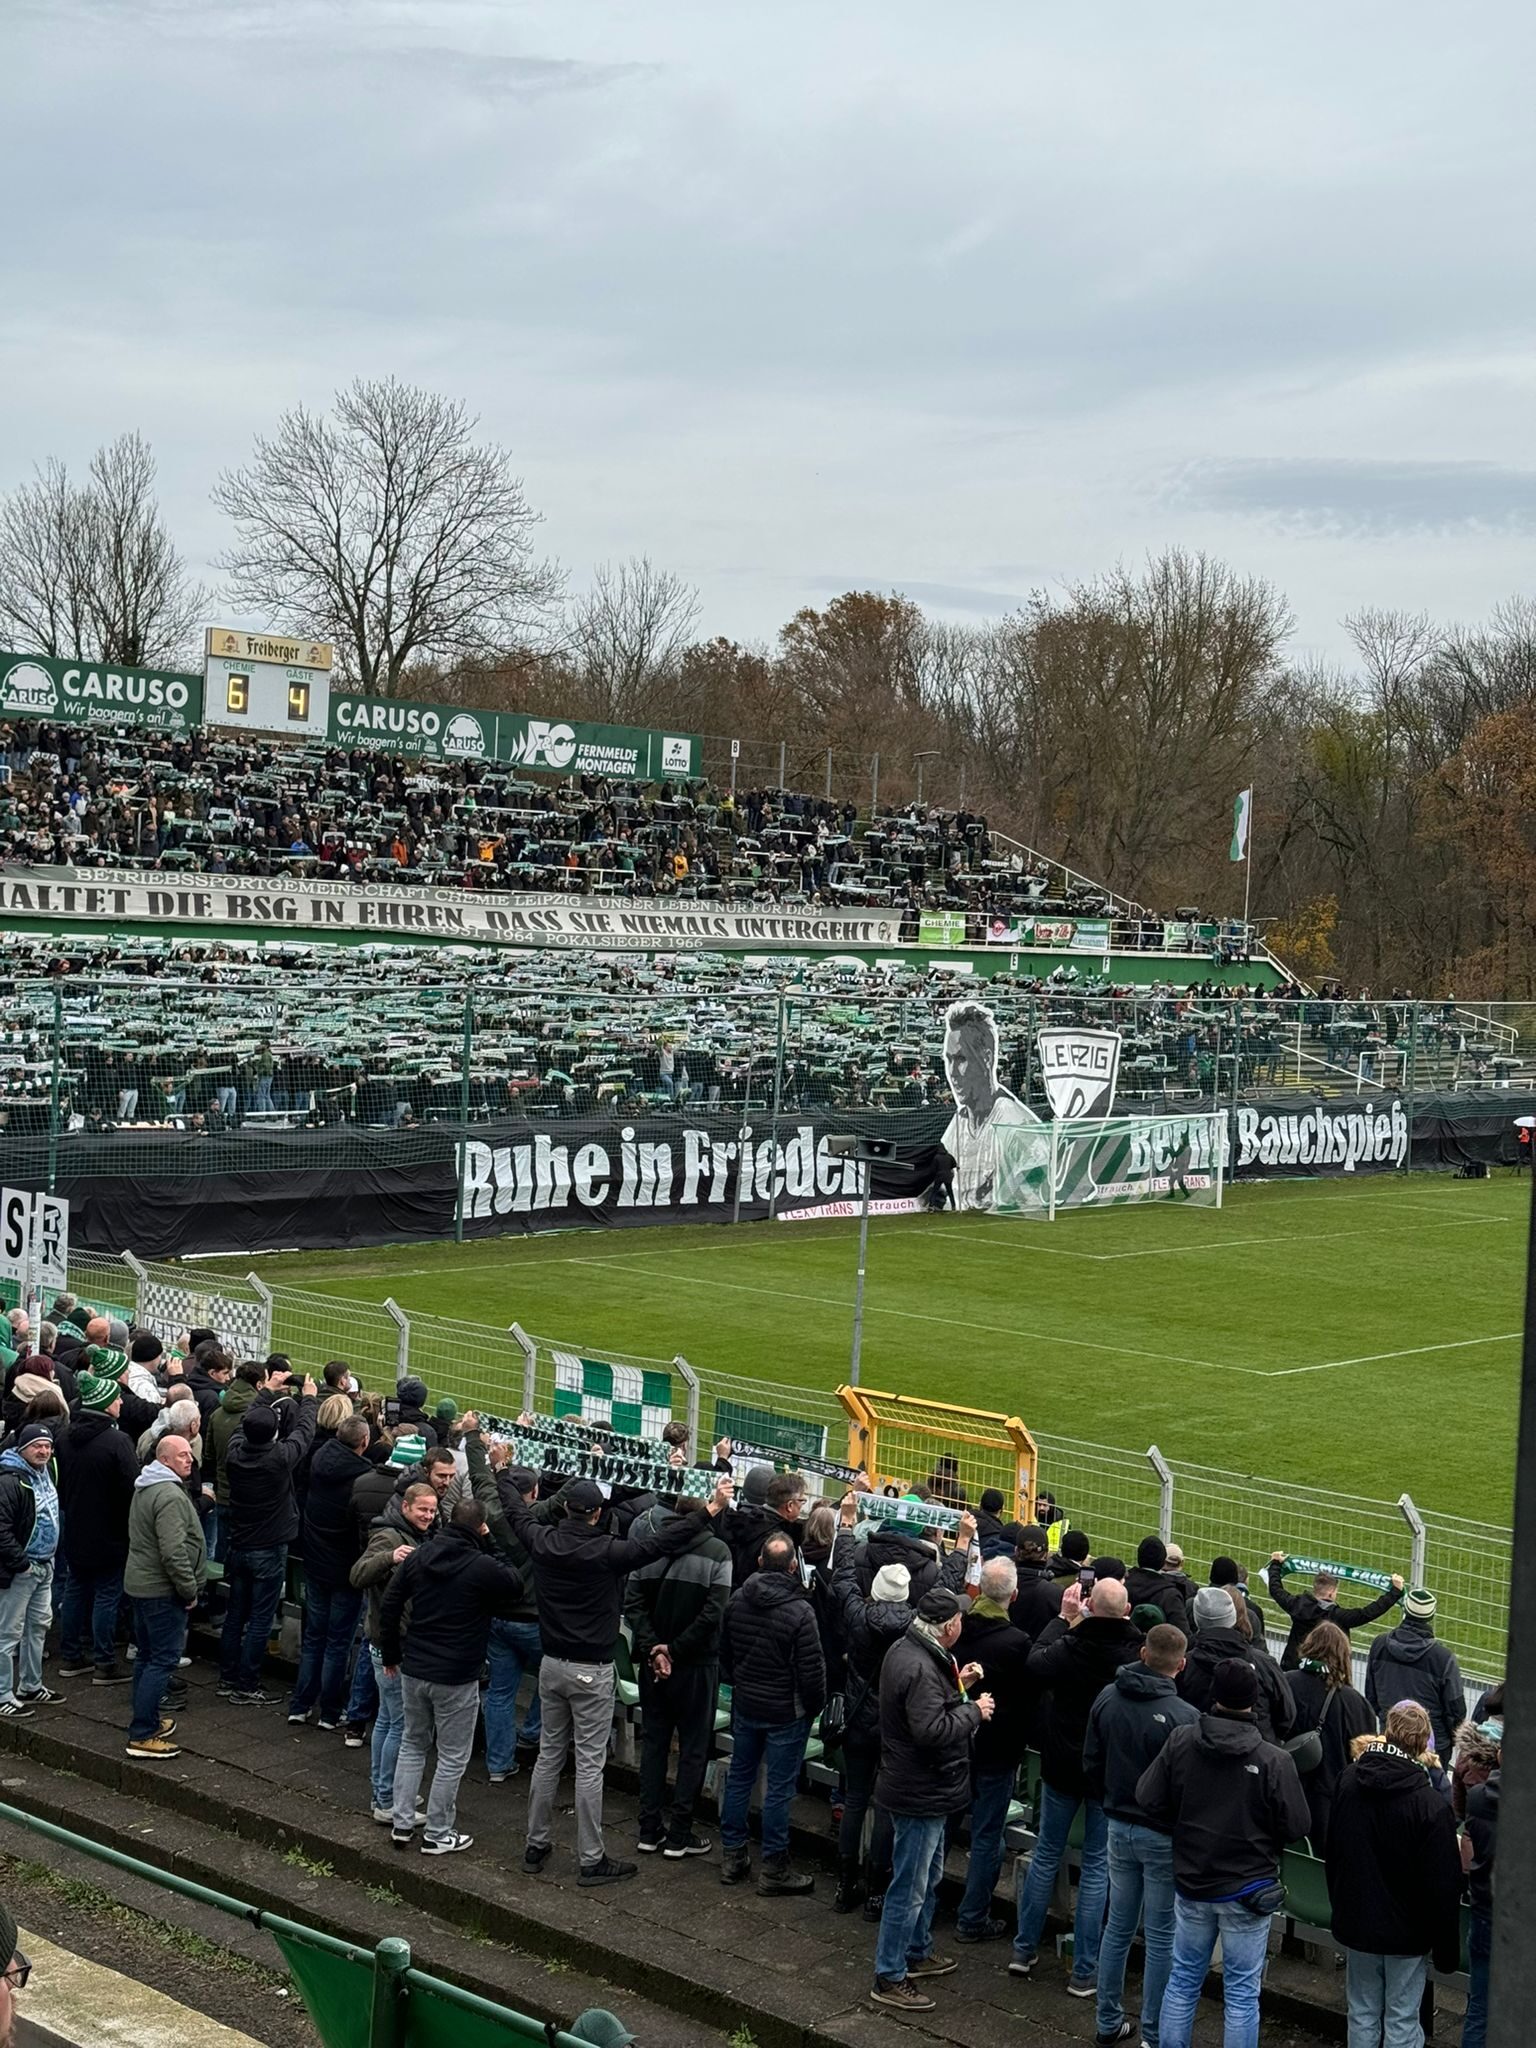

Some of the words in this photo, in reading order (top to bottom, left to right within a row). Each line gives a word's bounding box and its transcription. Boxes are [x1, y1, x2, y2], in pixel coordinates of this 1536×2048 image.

[246, 637, 300, 663] Freiberger
[223, 661, 256, 673] CHEMIE
[286, 669, 314, 681] GÄSTE
[0, 689, 58, 706] CARUSO
[62, 669, 189, 708] CARUSO
[228, 679, 243, 709] 6
[290, 688, 304, 715] 4
[64, 700, 86, 715] Wir
[147, 712, 165, 726] an!
[337, 702, 440, 736] CARUSO
[337, 730, 355, 743] Wir
[357, 731, 403, 750] baggern's
[406, 739, 421, 751] an!
[442, 737, 485, 751] CARUSO
[733, 742, 738, 752] B
[578, 744, 639, 761] FERNMELDE
[665, 758, 687, 767] LOTTO
[575, 758, 636, 775] MONTAGEN
[75, 868, 429, 899] BETRIEBSSPORTGEMEINSCHAFT
[435, 887, 512, 906] CHEMIE
[514, 894, 582, 908] LEIPZIG
[598, 897, 656, 911] UNSER
[659, 899, 710, 912] LEBEN
[714, 901, 747, 914] NUR
[786, 904, 823, 917] DICH
[146, 890, 213, 917] DIE
[225, 894, 298, 921] BSG
[311, 899, 345, 922] IN
[485, 909, 564, 932] DASS
[569, 911, 615, 933] SIE
[619, 914, 729, 937] NIEMALS
[735, 918, 874, 941] UNTERGEHT
[924, 919, 960, 928] CHEMIE
[495, 930, 536, 944] 1964
[545, 932, 663, 948] POKALSIEGER
[668, 936, 703, 949] 1966
[1237, 1100, 1408, 1171] Bauchspieß
[453, 1134, 610, 1221] Ruhe
[617, 1126, 674, 1207] in
[680, 1126, 870, 1205] Frieden
[1184, 1176, 1206, 1188] RANS
[820, 1203, 854, 1216] TRANS
[867, 1199, 915, 1211] Strauch
[5, 1197, 24, 1258] S
[1292, 1559, 1346, 1578] CHEMIE
[1351, 1570, 1392, 1587] FANS
